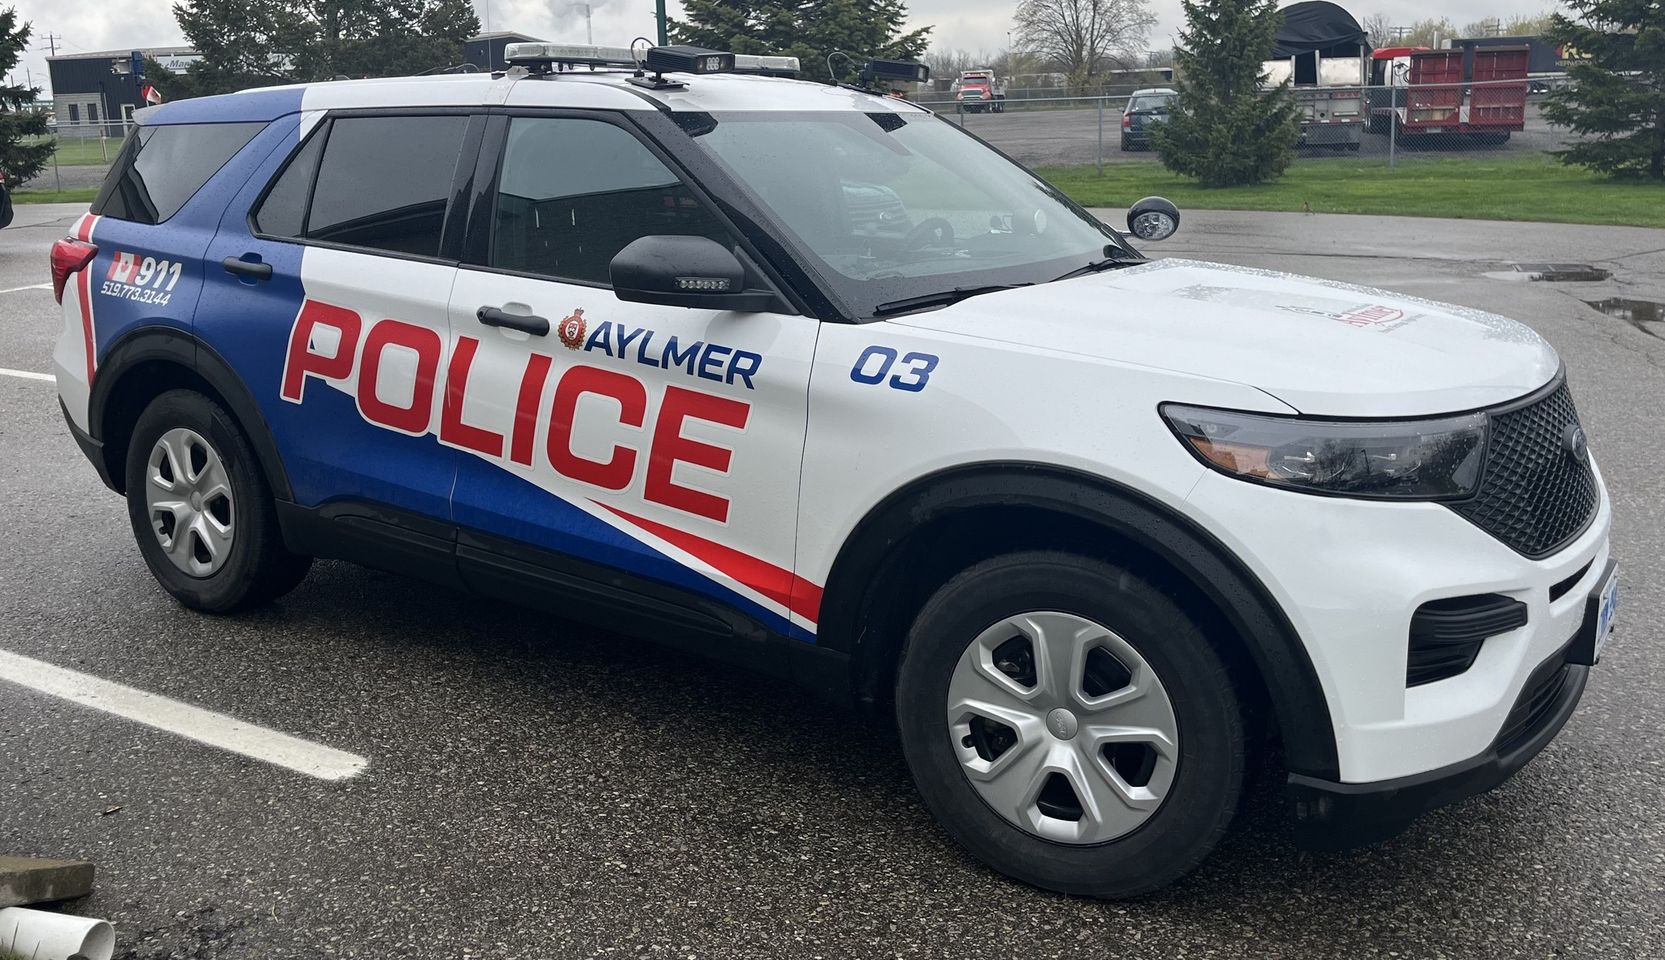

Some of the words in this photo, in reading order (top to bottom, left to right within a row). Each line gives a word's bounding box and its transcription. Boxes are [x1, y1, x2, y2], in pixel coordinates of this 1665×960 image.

[101, 281, 171, 307] 519.773.3144
[134, 257, 182, 292] 911
[583, 320, 763, 390] AYLMER
[850, 345, 940, 393] 03
[281, 299, 751, 524] POLICE
